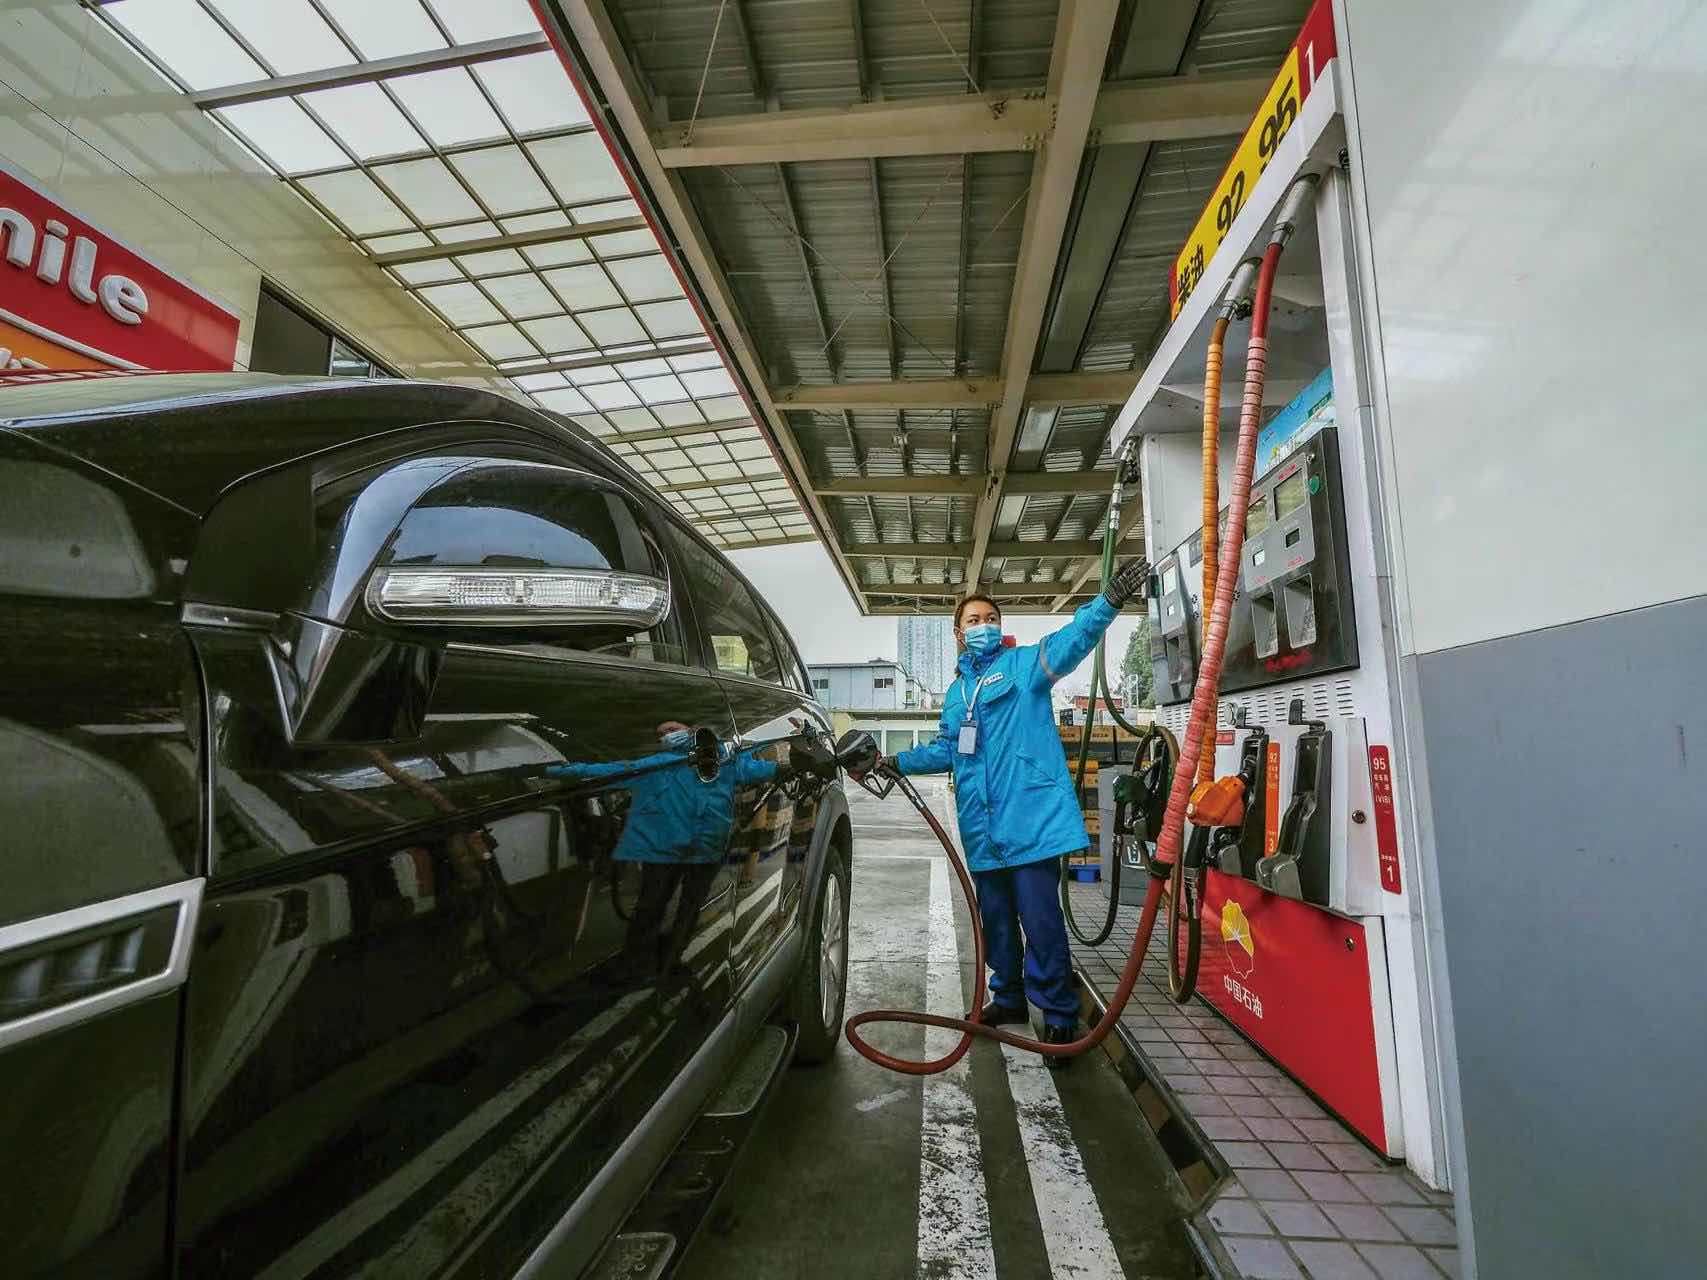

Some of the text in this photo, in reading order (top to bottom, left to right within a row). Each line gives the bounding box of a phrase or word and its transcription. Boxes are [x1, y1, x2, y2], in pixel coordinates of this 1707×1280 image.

[1304, 40, 1315, 92] 1
[1217, 170, 1247, 246] 92
[1259, 76, 1297, 174] 95
[1373, 757, 1386, 770] 95
[1387, 865, 1394, 882] 1
[1223, 974, 1263, 1019] 中国石油
